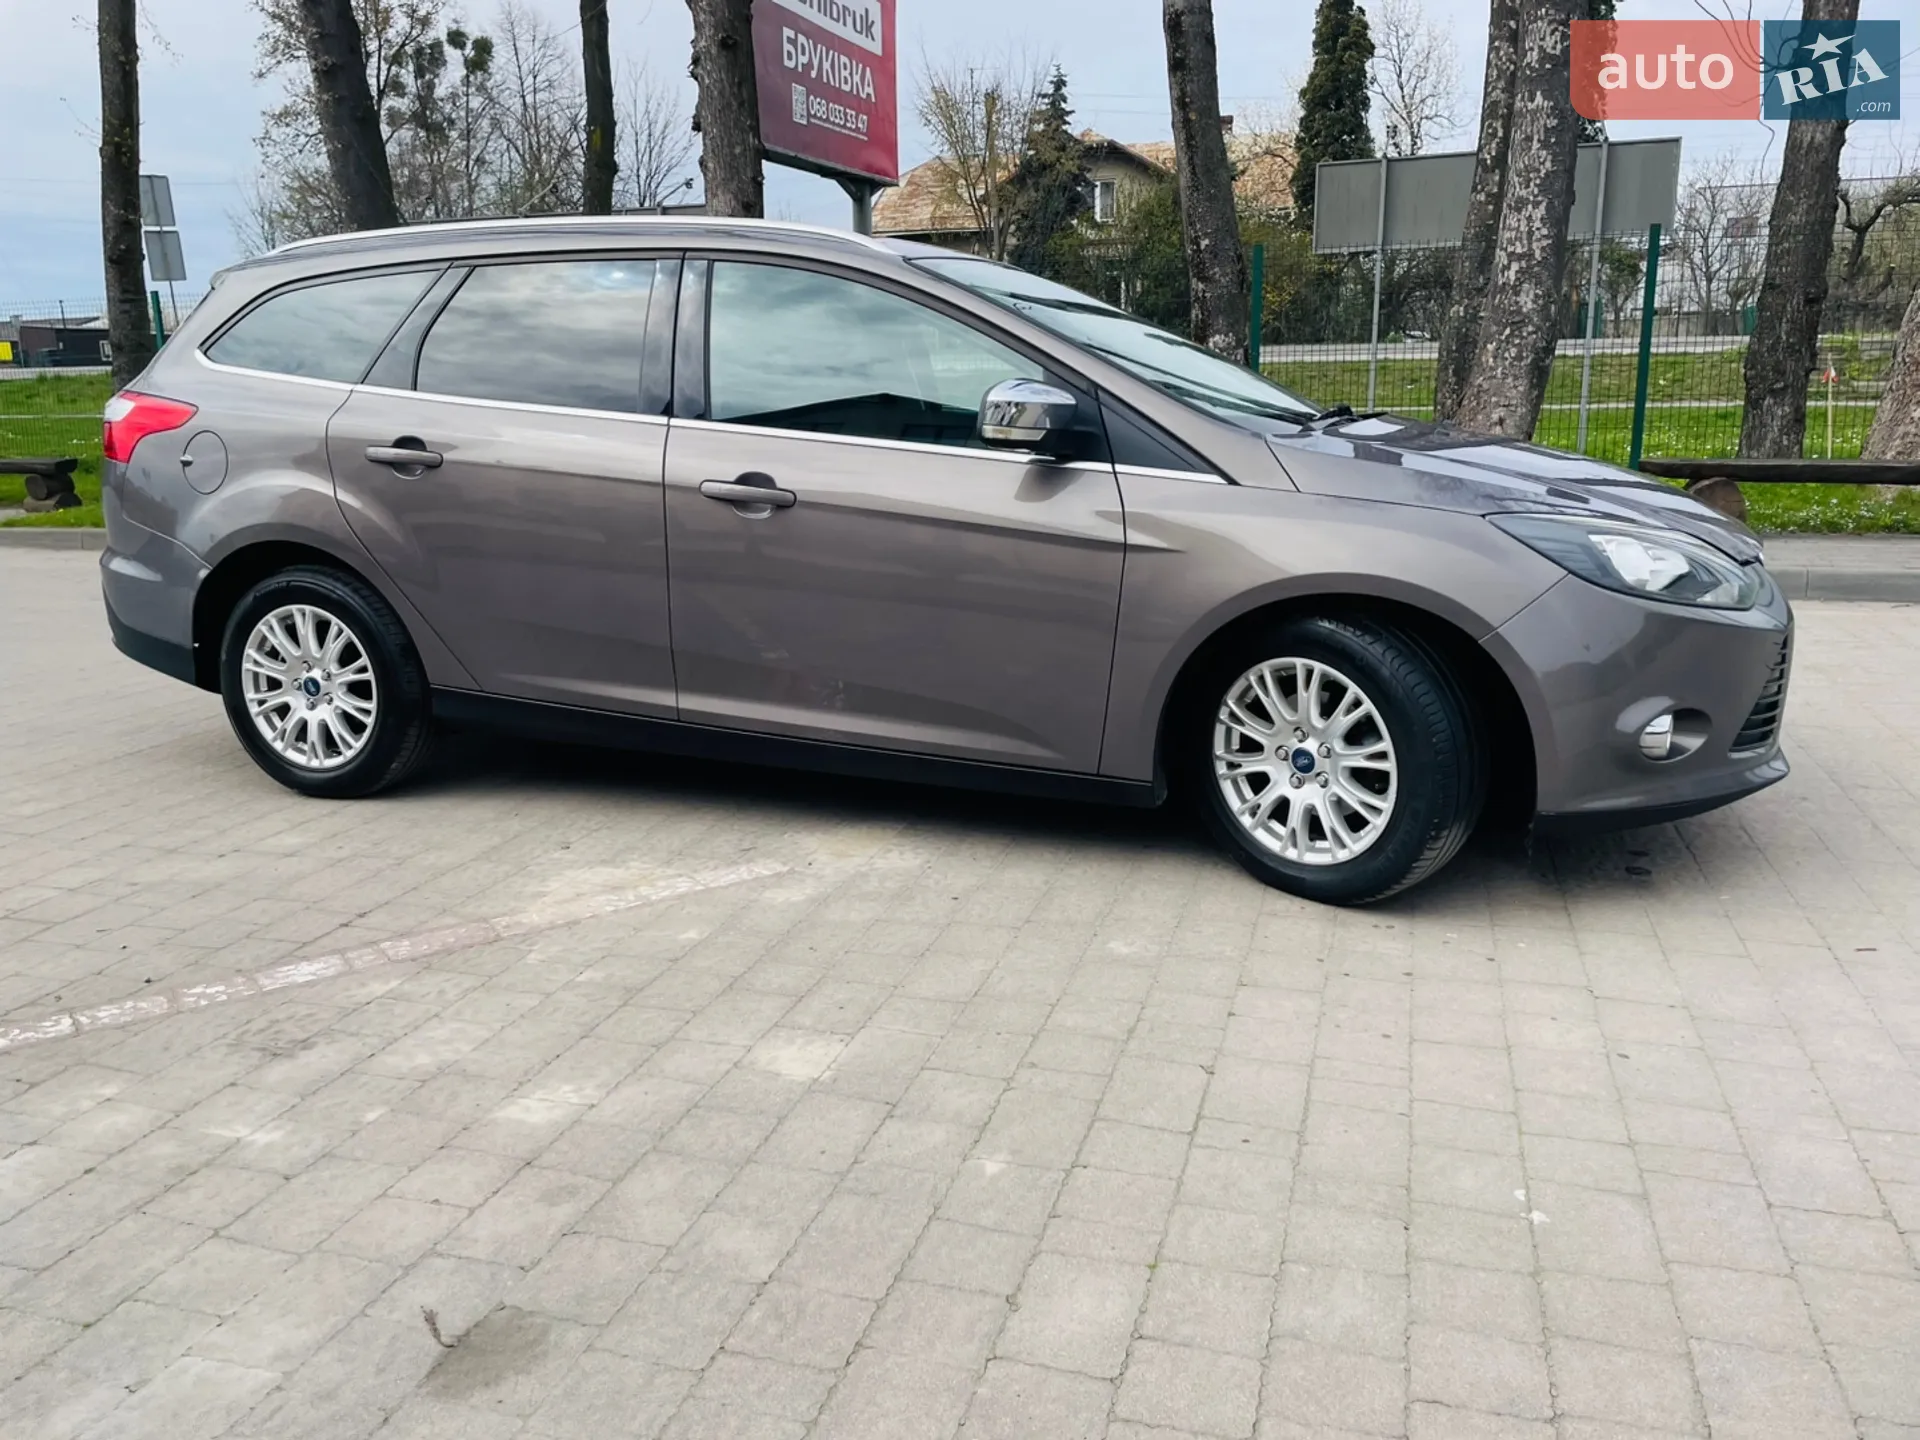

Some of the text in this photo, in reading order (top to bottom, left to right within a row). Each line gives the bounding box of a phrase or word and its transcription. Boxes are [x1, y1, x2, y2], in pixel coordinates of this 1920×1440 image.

[782, 26, 876, 103] БРУКІВКА
[809, 95, 827, 119] 068
[829, 102, 845, 126] 033
[845, 108, 856, 129] 33
